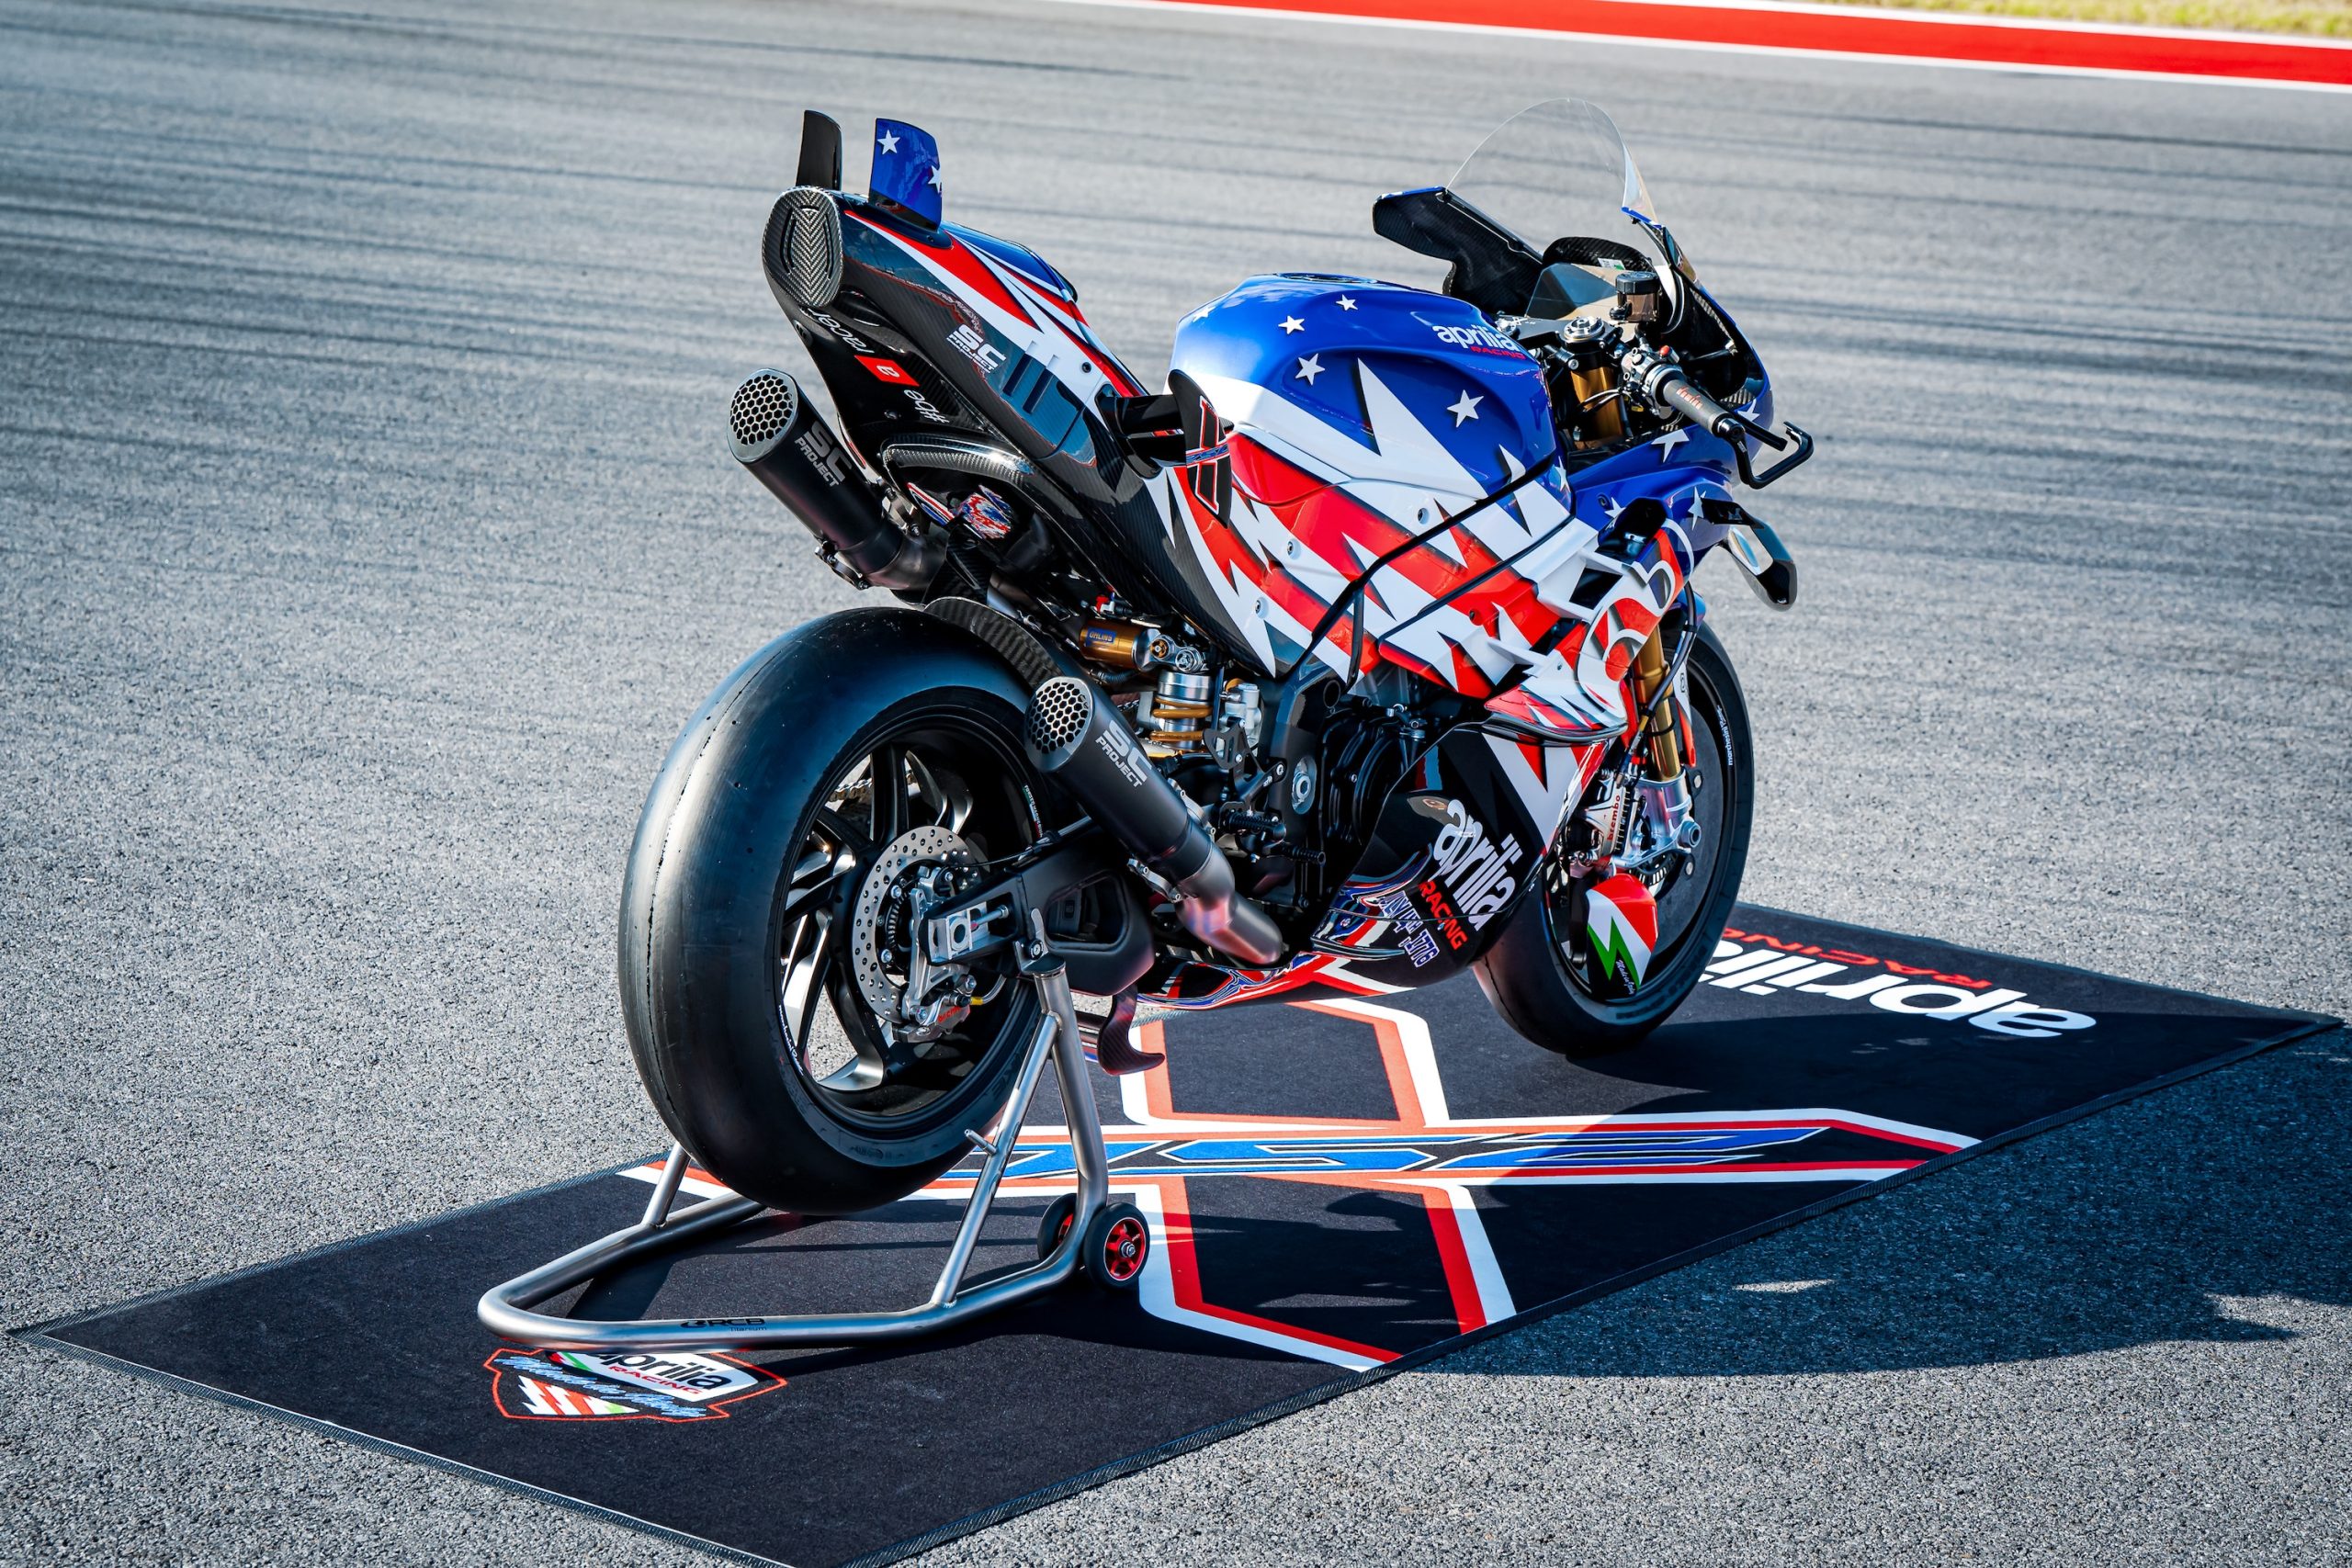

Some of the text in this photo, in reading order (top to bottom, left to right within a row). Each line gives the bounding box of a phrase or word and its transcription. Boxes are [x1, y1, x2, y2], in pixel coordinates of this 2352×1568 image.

[945, 333, 997, 372] PROJECT
[948, 323, 1007, 368] SC
[1432, 324, 1521, 352] aprilia
[1470, 345, 1526, 360] RACING
[807, 308, 950, 423] #be a racer
[794, 434, 840, 487] PROJECT
[802, 420, 853, 482] SC
[1094, 735, 1143, 787] PROJECT
[1102, 719, 1152, 783] SC
[1606, 795, 1621, 841] brembo
[1427, 798, 1524, 931] aprilia
[1418, 879, 1468, 951] RACING
[596, 1352, 733, 1390] prilia
[607, 1365, 703, 1395] RACING
